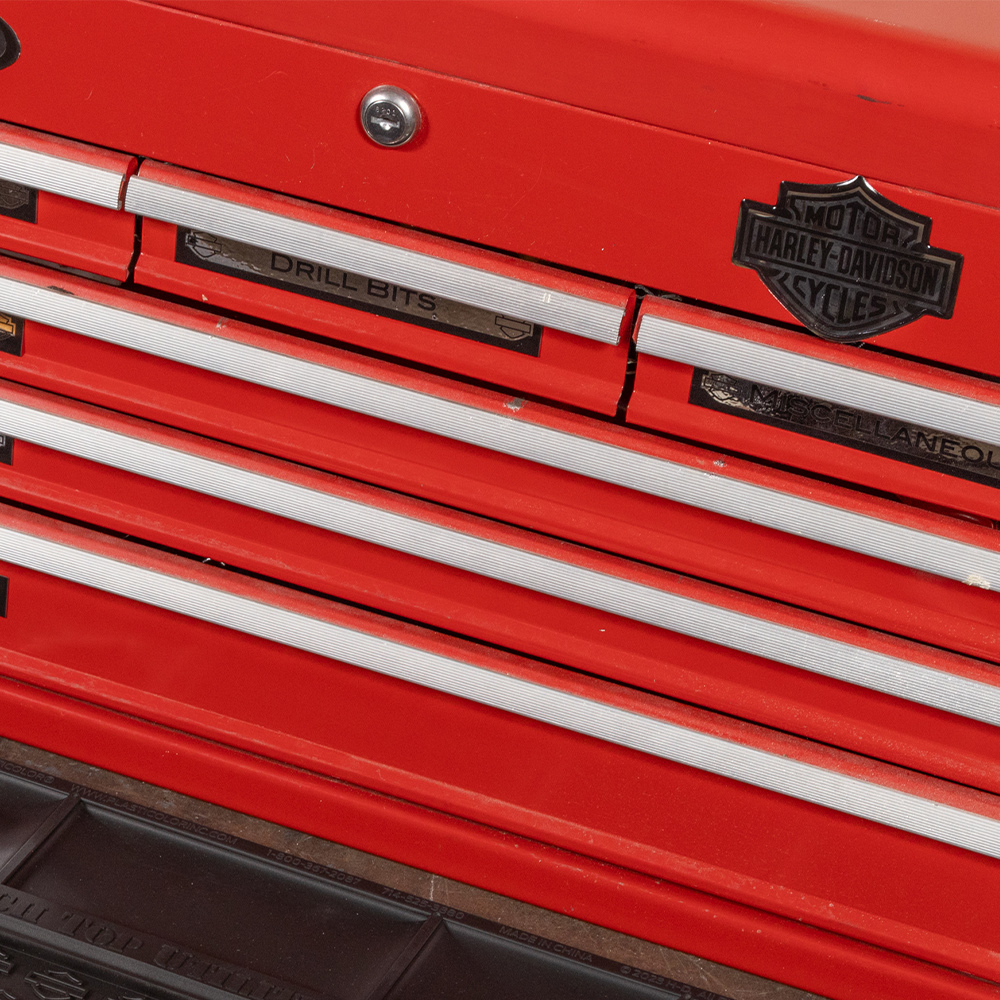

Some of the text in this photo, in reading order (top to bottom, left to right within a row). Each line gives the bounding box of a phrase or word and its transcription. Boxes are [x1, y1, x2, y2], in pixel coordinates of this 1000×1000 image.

[805, 202, 900, 245] MOTOR
[271, 252, 436, 311] DRILL BITS
[757, 224, 940, 296] HARLEY-DAVIDSON
[793, 276, 887, 323] CYCLES
[55, 907, 145, 955] TOP
[500, 925, 593, 963] MADE IN CHINA
